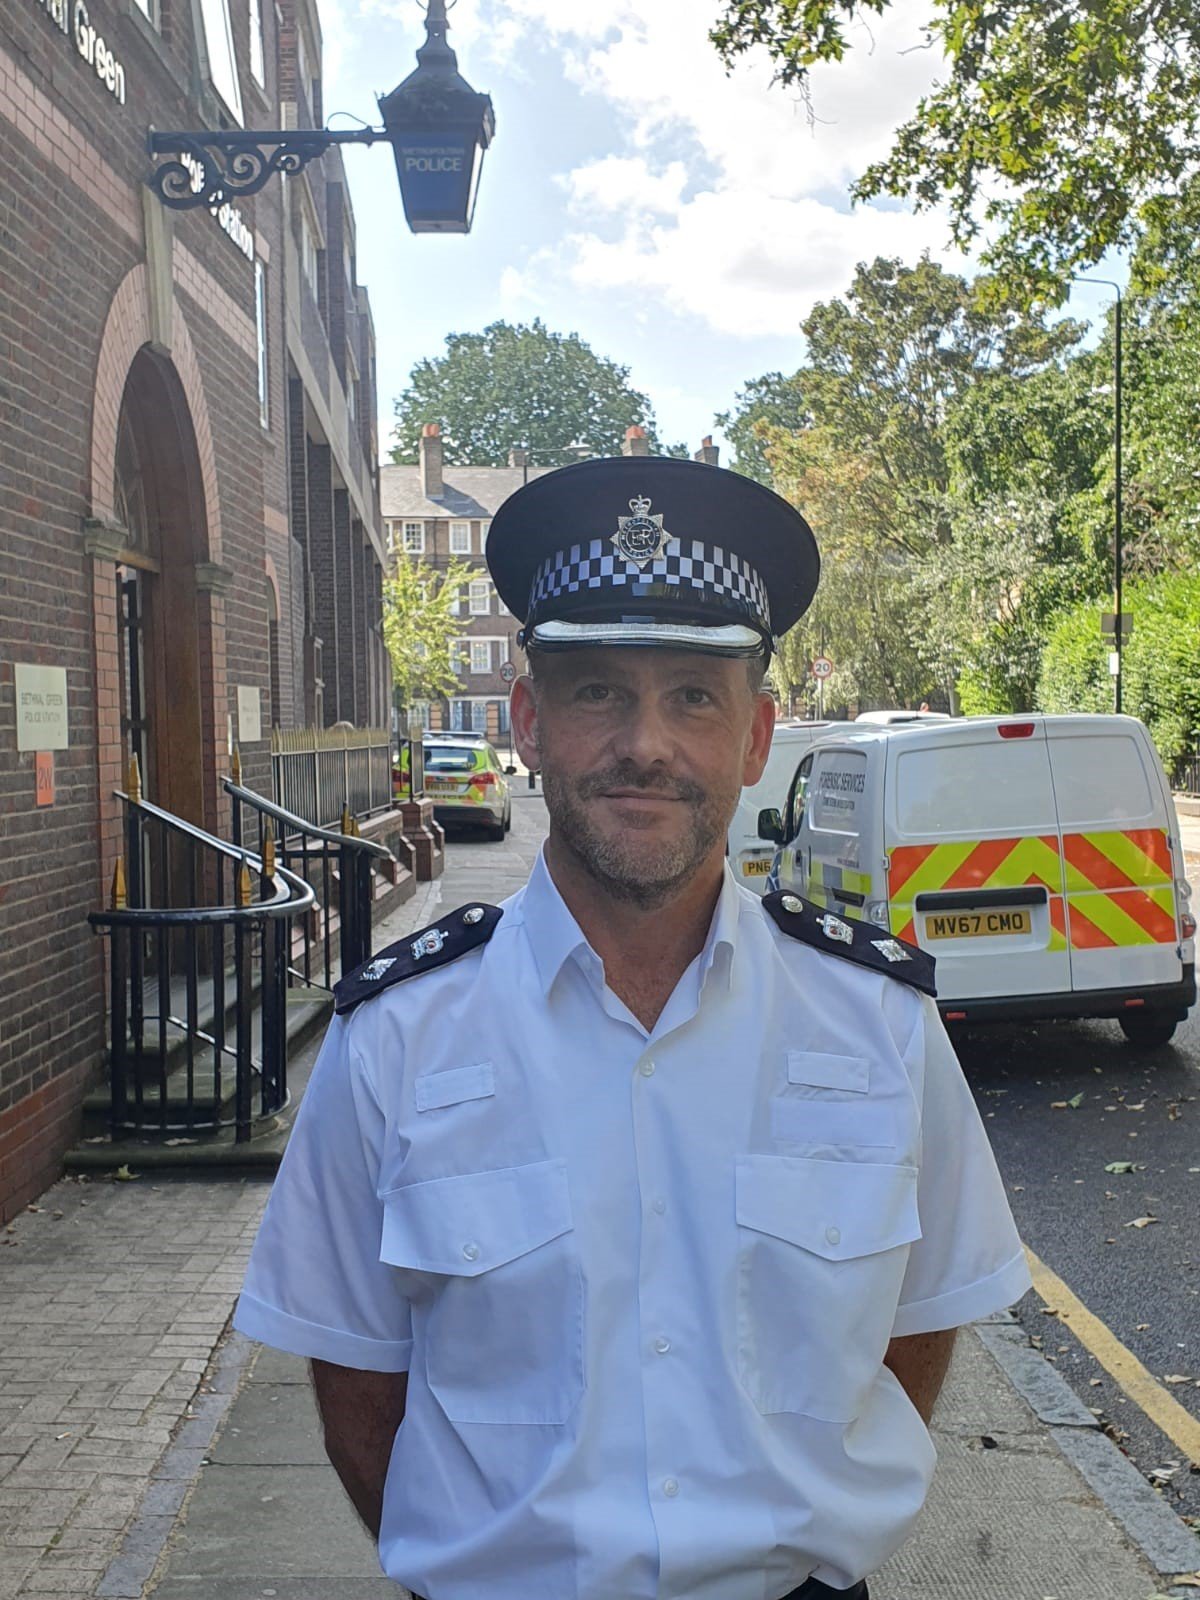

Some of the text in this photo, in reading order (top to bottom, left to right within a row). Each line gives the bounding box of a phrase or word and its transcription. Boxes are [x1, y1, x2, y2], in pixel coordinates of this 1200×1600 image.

[74, 0, 125, 104] Green
[405, 157, 462, 172] POLICE
[815, 663, 830, 672] 20
[748, 861, 771, 873] PN6
[933, 913, 1023, 935] MV67 CMO
